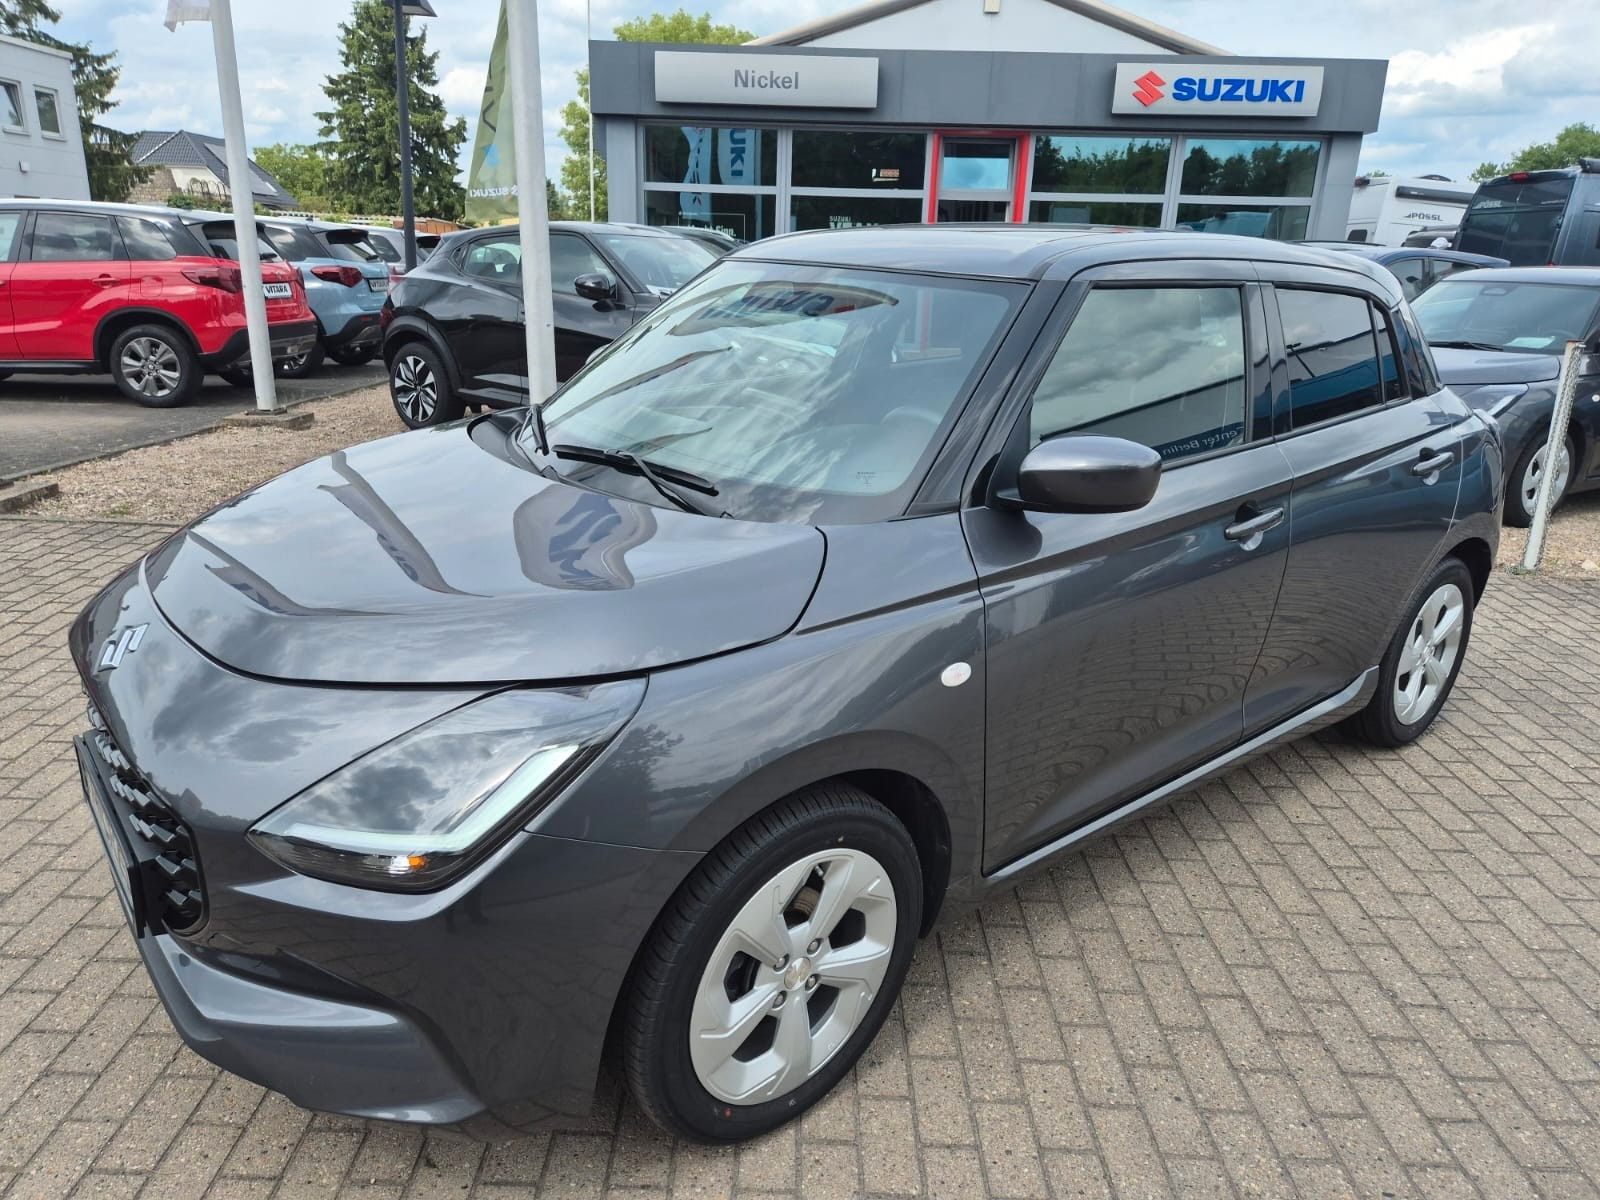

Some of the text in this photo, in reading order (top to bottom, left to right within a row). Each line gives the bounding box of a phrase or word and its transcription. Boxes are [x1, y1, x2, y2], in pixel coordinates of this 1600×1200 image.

[734, 69, 799, 90] Nickel
[1172, 77, 1305, 103] SUZUKI
[265, 284, 289, 295] VITARA
